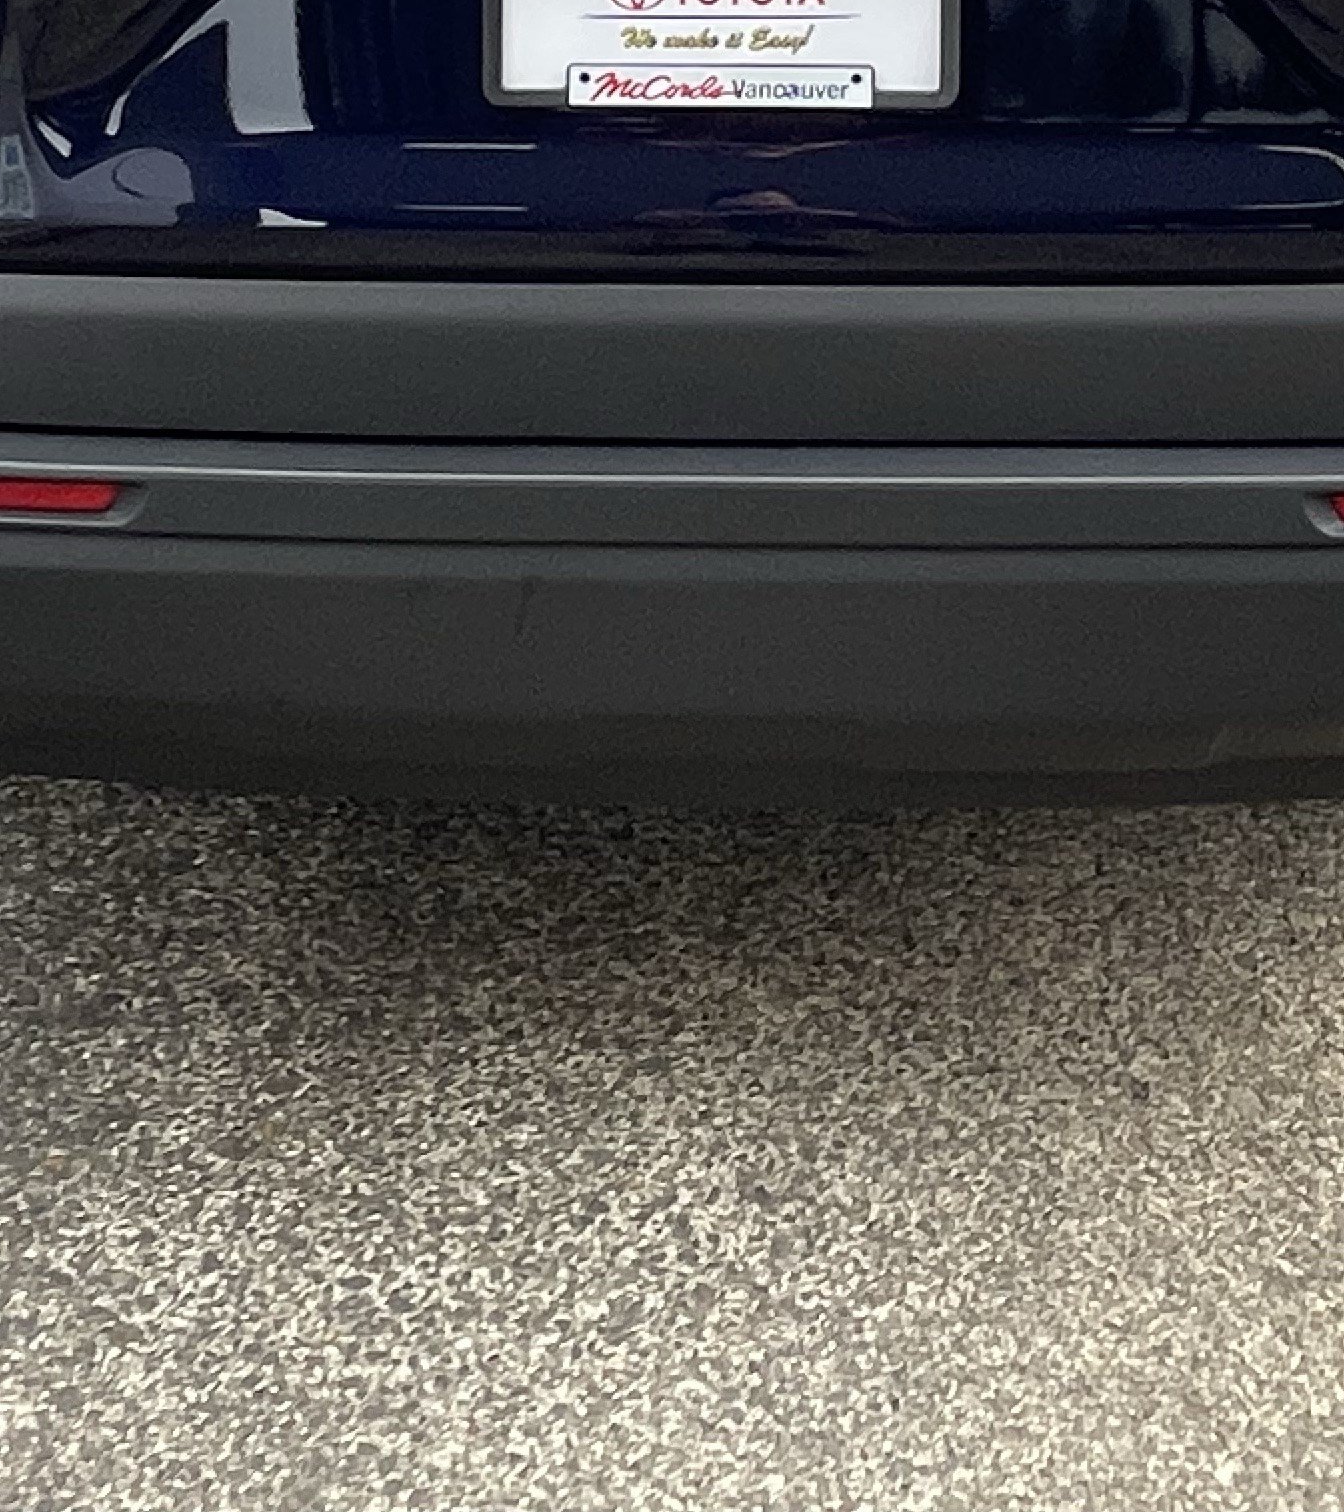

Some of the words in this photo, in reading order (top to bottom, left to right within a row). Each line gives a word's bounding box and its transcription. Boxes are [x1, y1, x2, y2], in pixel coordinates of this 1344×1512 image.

[620, 26, 657, 48] We
[663, 27, 719, 48] make
[725, 31, 744, 49] it
[748, 24, 815, 55] Easy!
[589, 72, 728, 101] McCords
[732, 78, 850, 99] Vancouver
